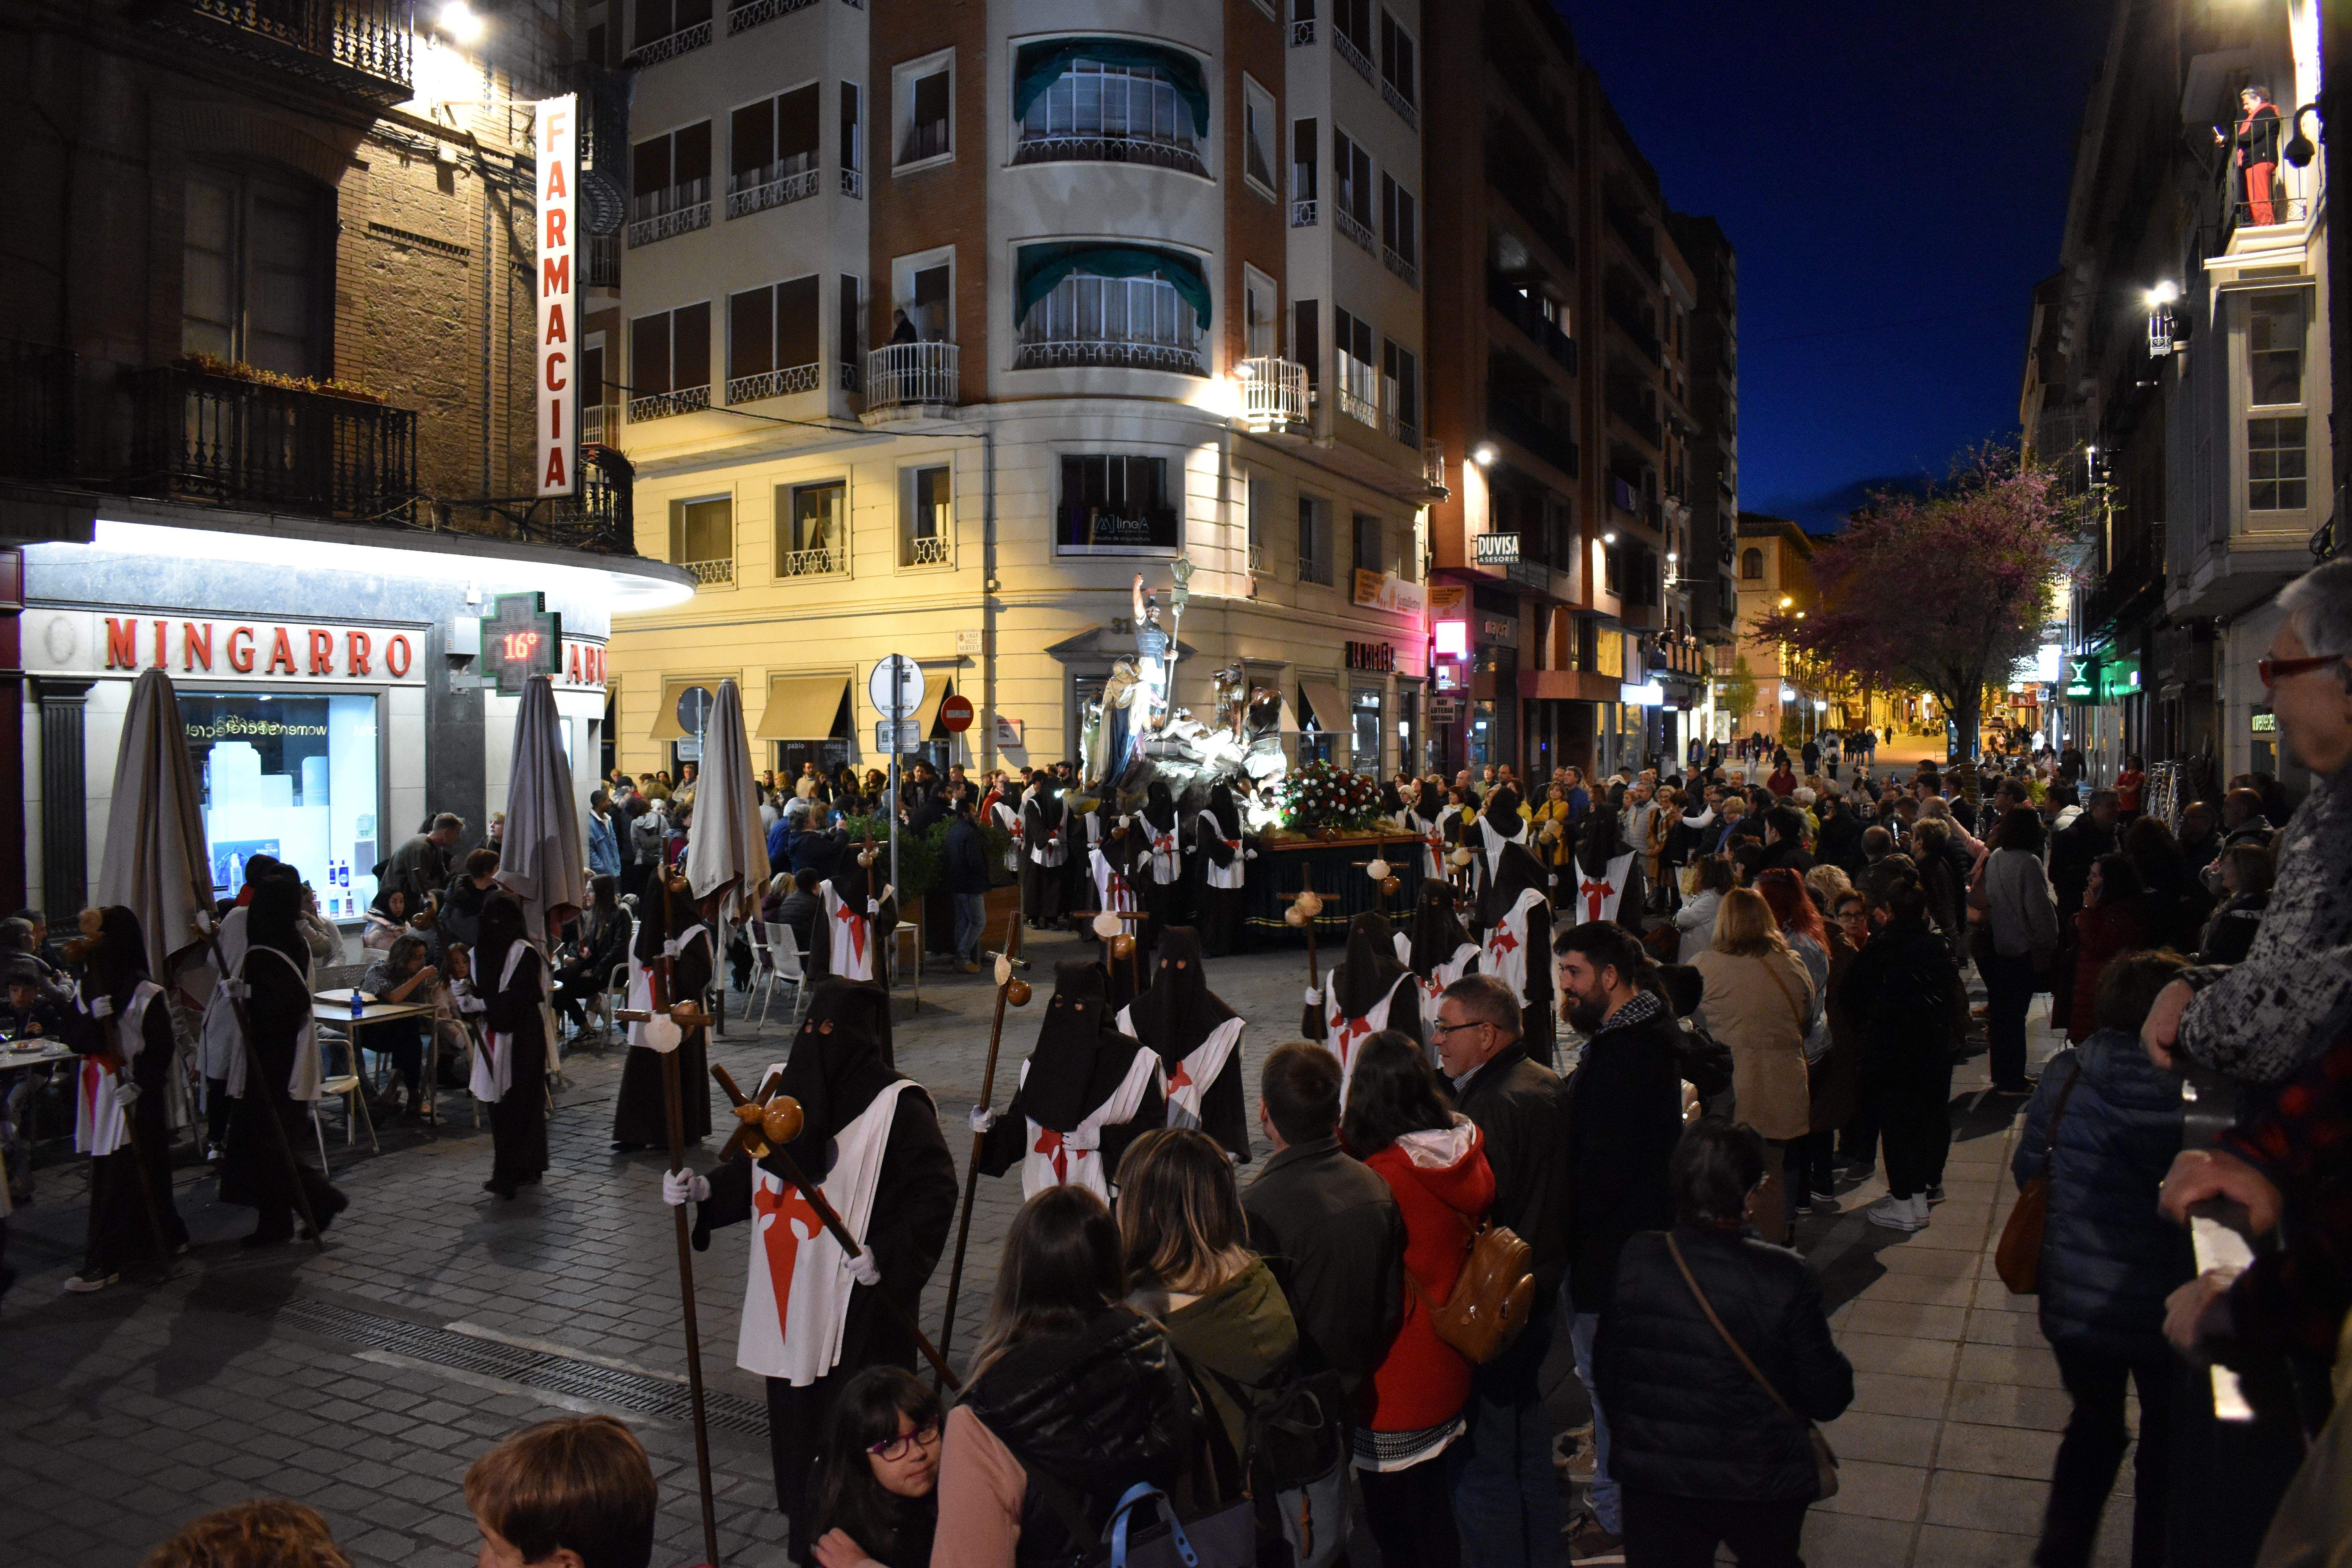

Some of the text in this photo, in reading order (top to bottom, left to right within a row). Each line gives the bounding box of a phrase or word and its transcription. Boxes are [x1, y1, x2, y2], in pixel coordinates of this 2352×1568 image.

[544, 111, 568, 488] FARMACIA
[1478, 535, 1519, 555] DUVISA
[1111, 617, 1133, 634] 31
[105, 617, 412, 677] MINGARRO
